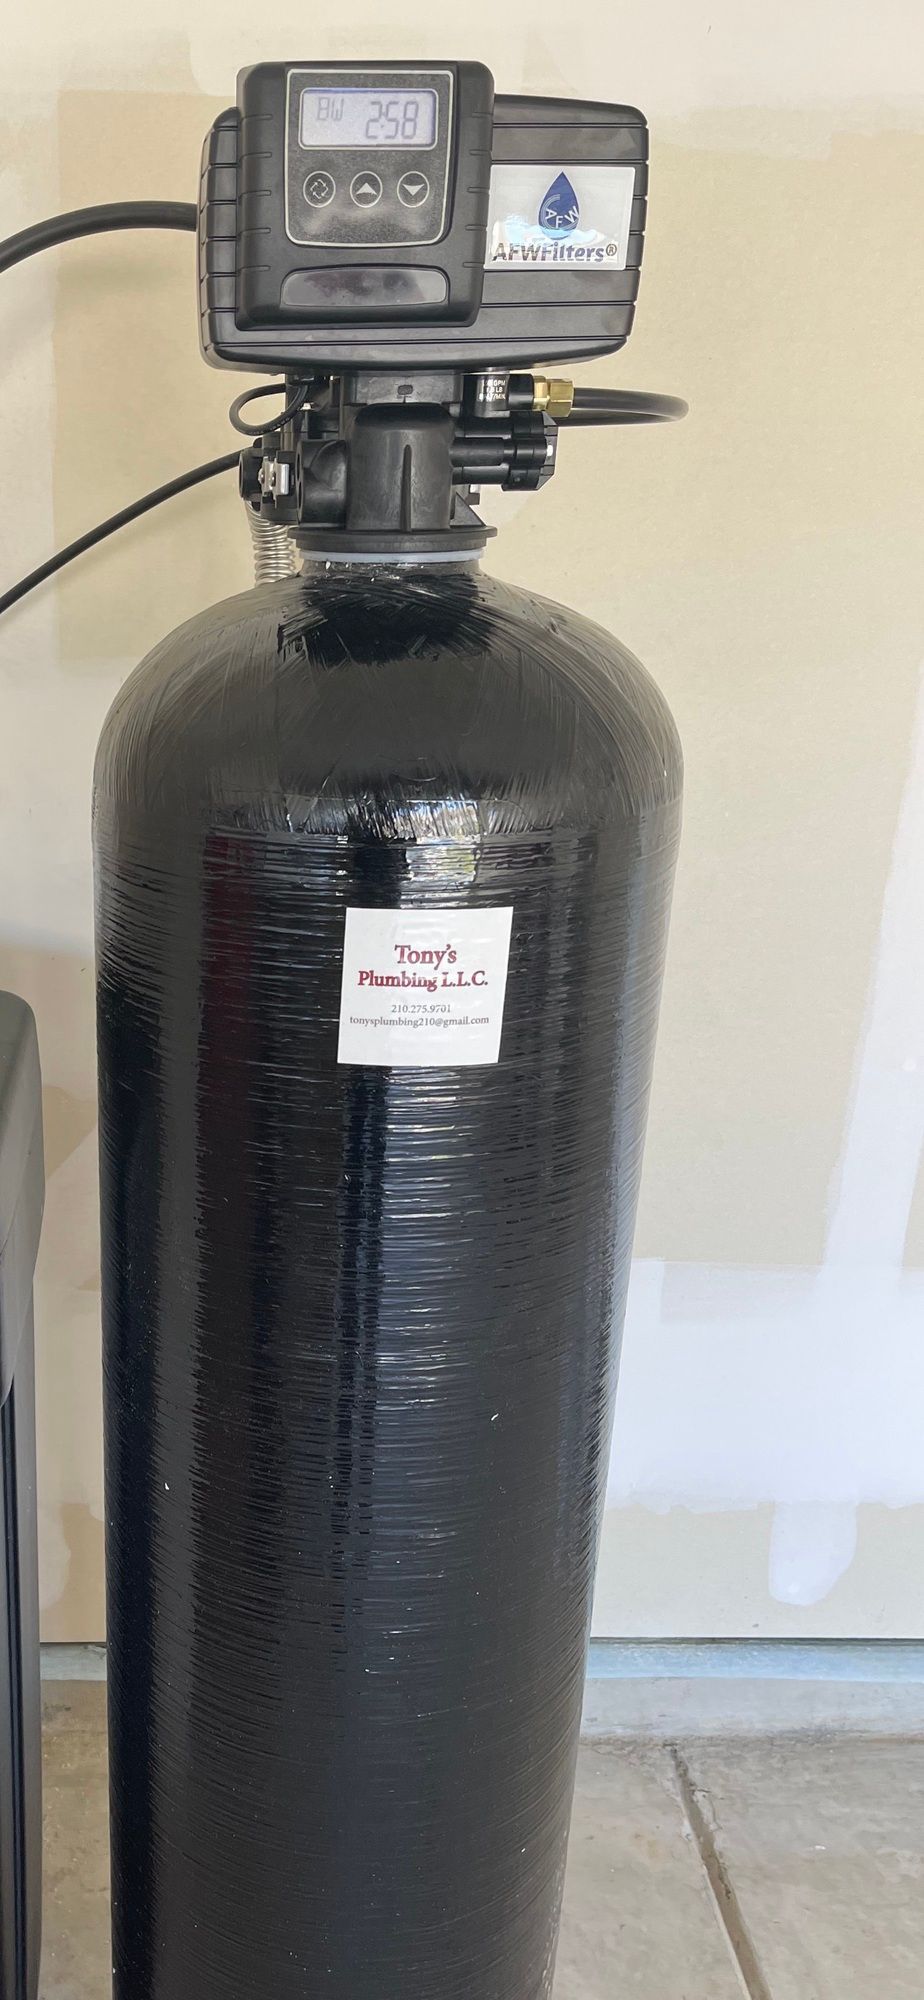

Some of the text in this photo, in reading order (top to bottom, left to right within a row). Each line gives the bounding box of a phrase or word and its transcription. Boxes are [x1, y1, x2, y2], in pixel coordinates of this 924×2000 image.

[316, 97, 419, 139] BW 2:58
[545, 206, 579, 229] AFW
[394, 944, 457, 970] Tony's
[357, 970, 488, 992] Plumbing L.L.C.
[391, 1004, 451, 1014] 210.275.9701
[350, 1016, 489, 1028] tonysplumbing210@gmail.com
